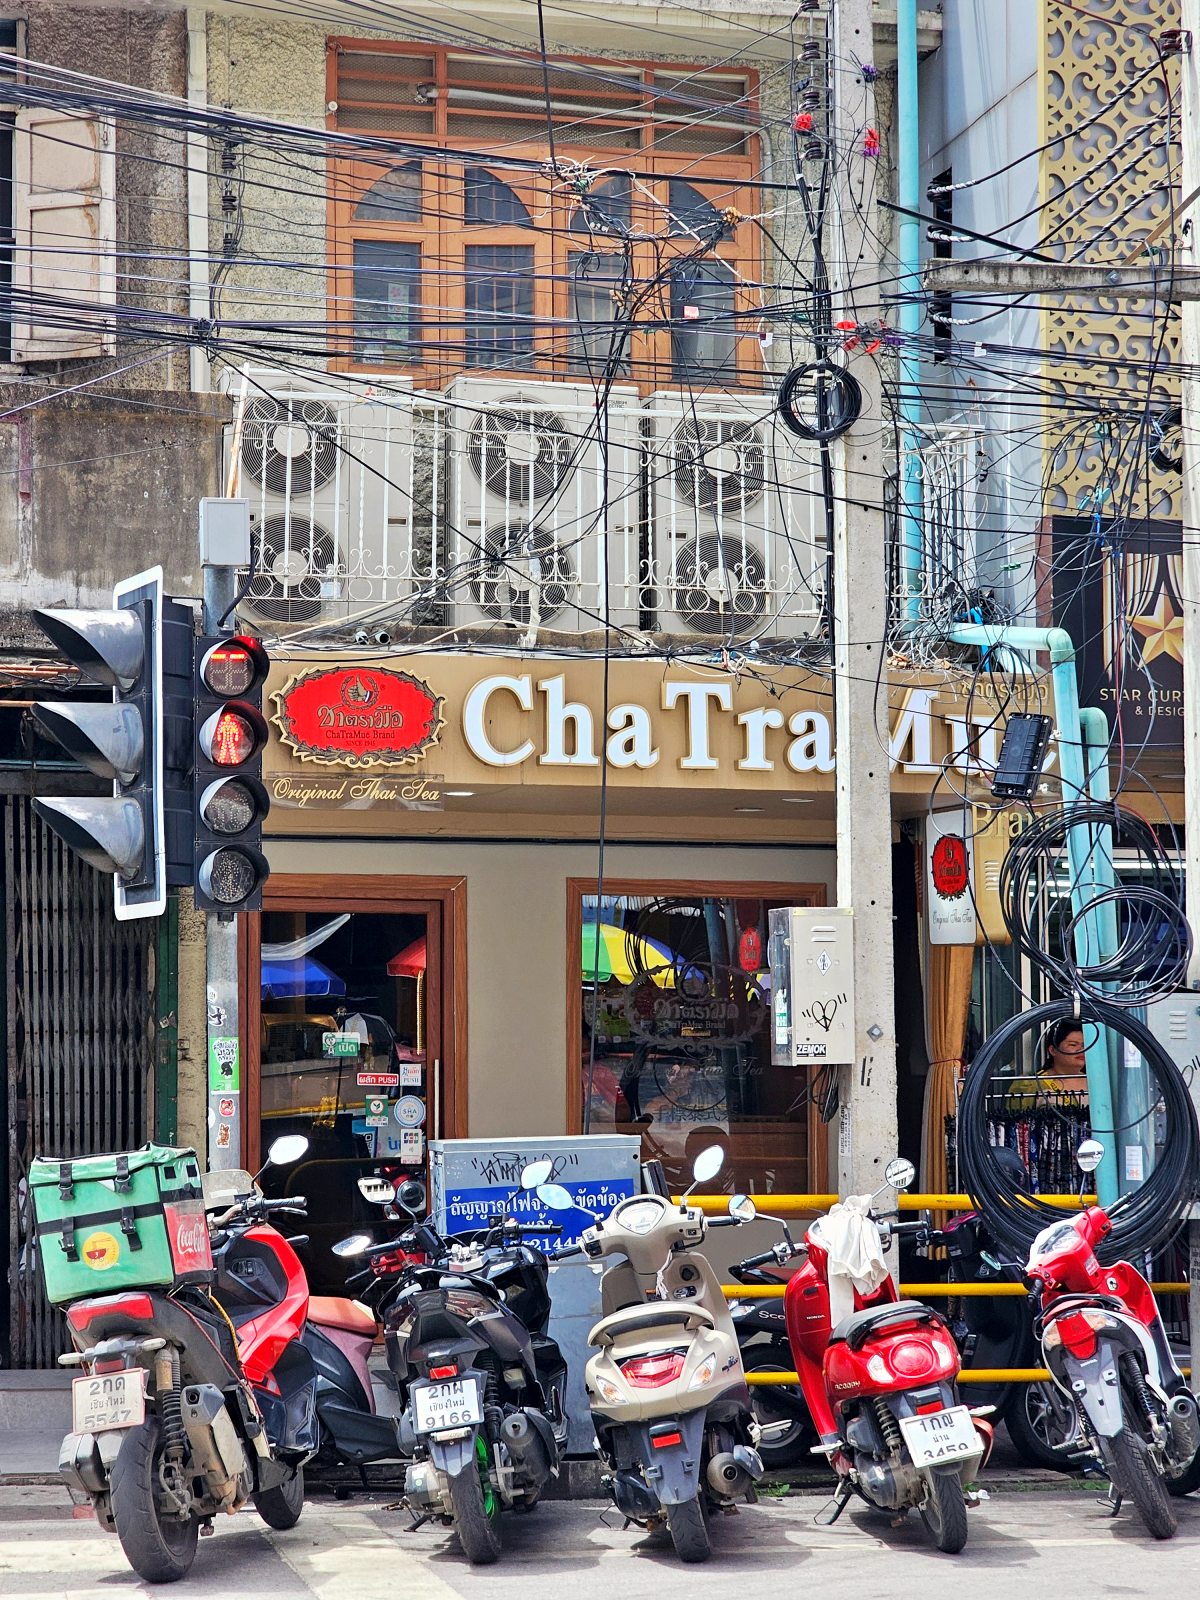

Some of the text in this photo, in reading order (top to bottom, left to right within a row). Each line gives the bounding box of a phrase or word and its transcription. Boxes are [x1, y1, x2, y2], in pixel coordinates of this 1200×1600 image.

[1100, 688, 1184, 702] STAR CUR
[317, 704, 404, 729] ชาตรามือ
[1135, 706, 1184, 716] & DESIG
[463, 673, 1057, 775] ChaTraMu
[325, 730, 395, 739] ChaTraMue Brand
[272, 777, 440, 806] Original Thai Tea
[338, 1042, 356, 1053] เปิด
[797, 1044, 826, 1054] ZEMOK
[359, 1075, 397, 1084] ผลัก PUSH
[425, 1410, 472, 1429] 9166
